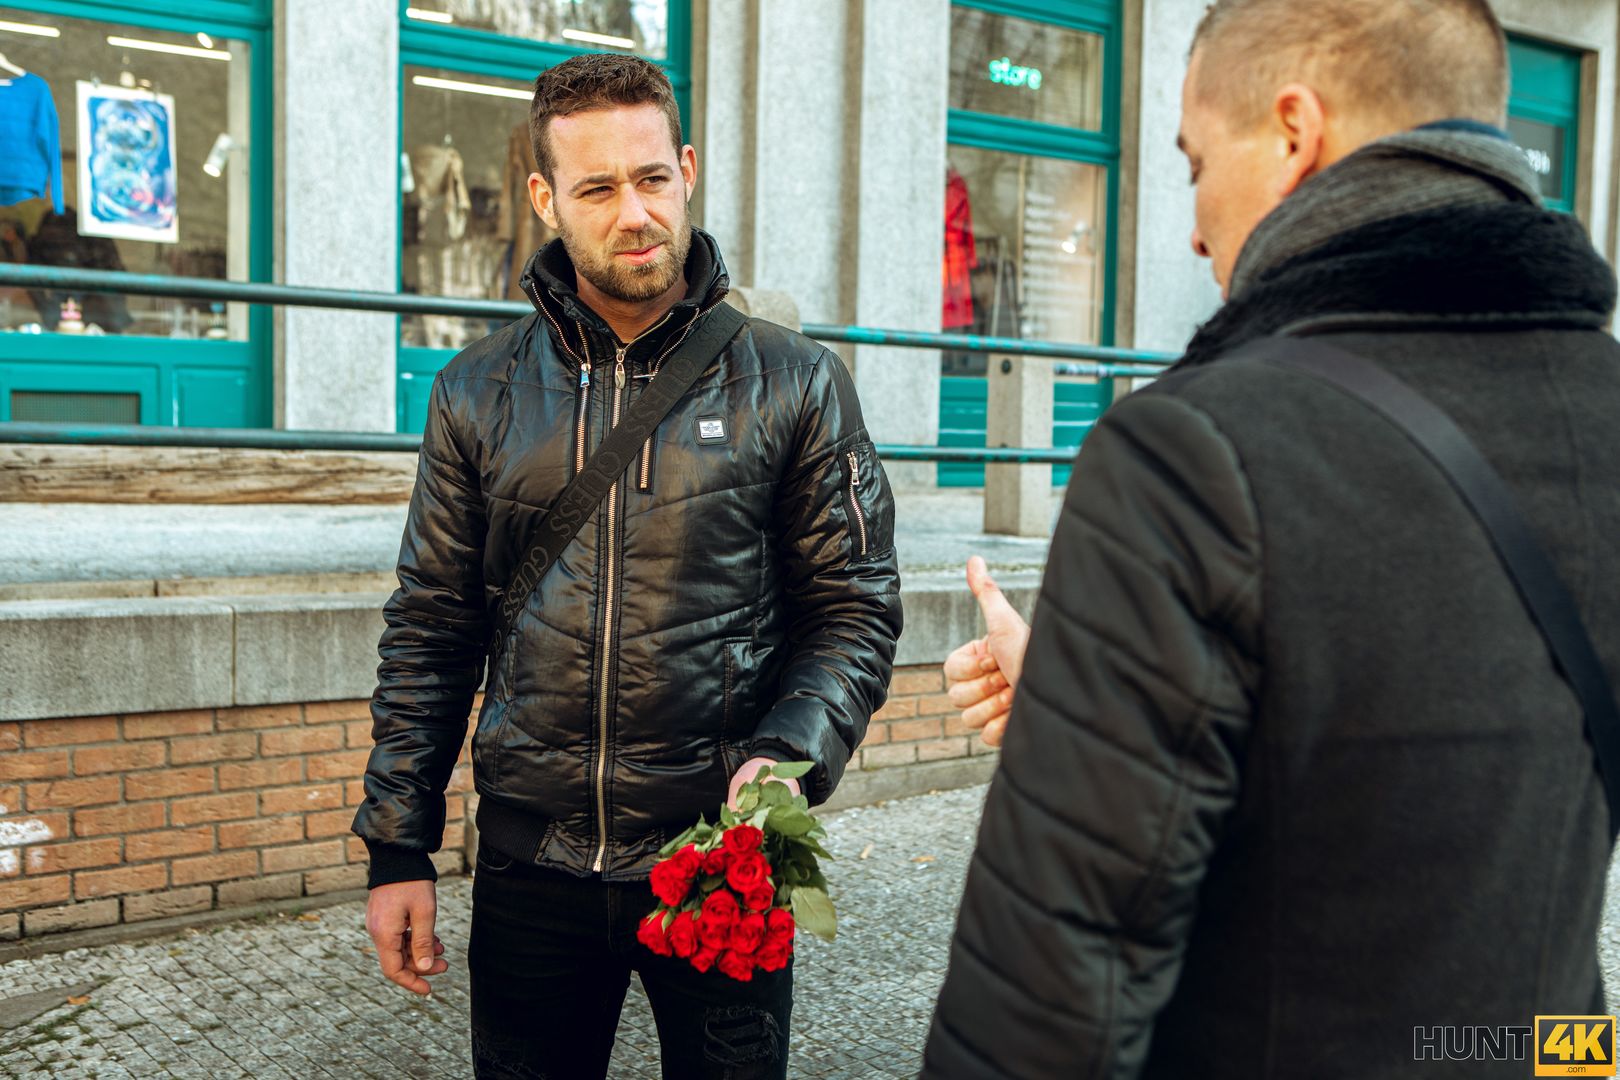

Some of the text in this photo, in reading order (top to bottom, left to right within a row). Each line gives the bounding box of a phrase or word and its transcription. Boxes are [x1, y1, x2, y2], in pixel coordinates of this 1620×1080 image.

[989, 56, 1042, 90] store
[550, 451, 621, 538] GUESS
[503, 545, 549, 625] GUESS
